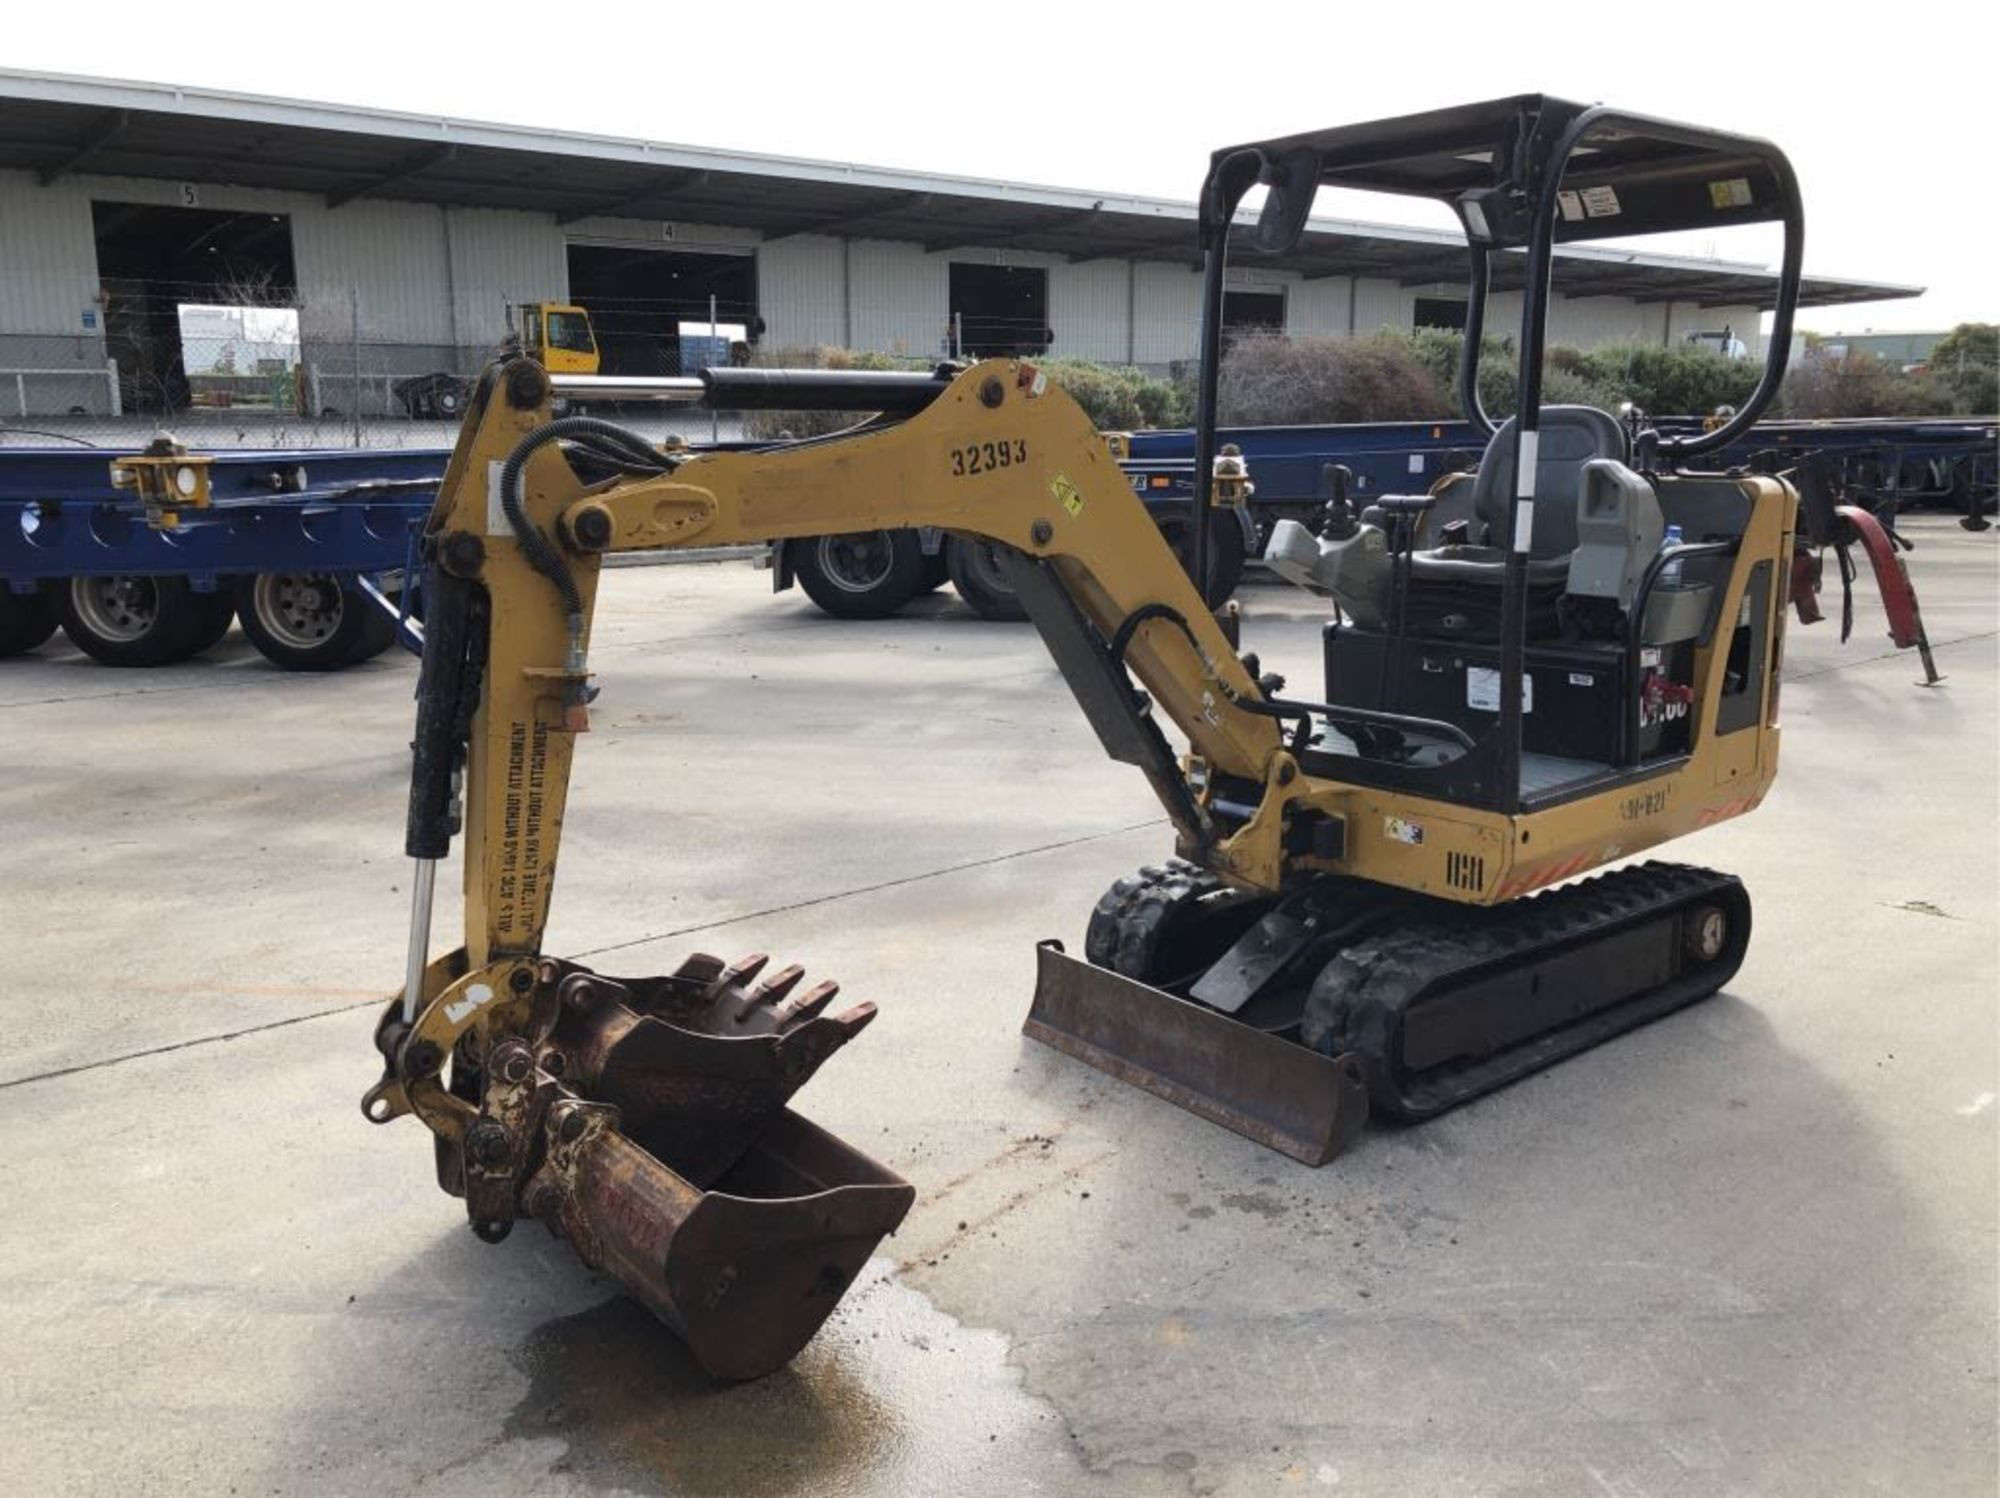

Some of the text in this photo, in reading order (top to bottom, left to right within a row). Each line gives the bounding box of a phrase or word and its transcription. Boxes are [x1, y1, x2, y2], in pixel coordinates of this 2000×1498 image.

[185, 186, 194, 204] 5
[665, 224, 673, 238] 4
[951, 439, 1027, 476] 32393
[508, 721, 526, 790] ATTACHMENT
[530, 720, 548, 788] ATTACHMENT
[505, 792, 521, 838] WITHOUT
[526, 791, 542, 836] WITHOUT
